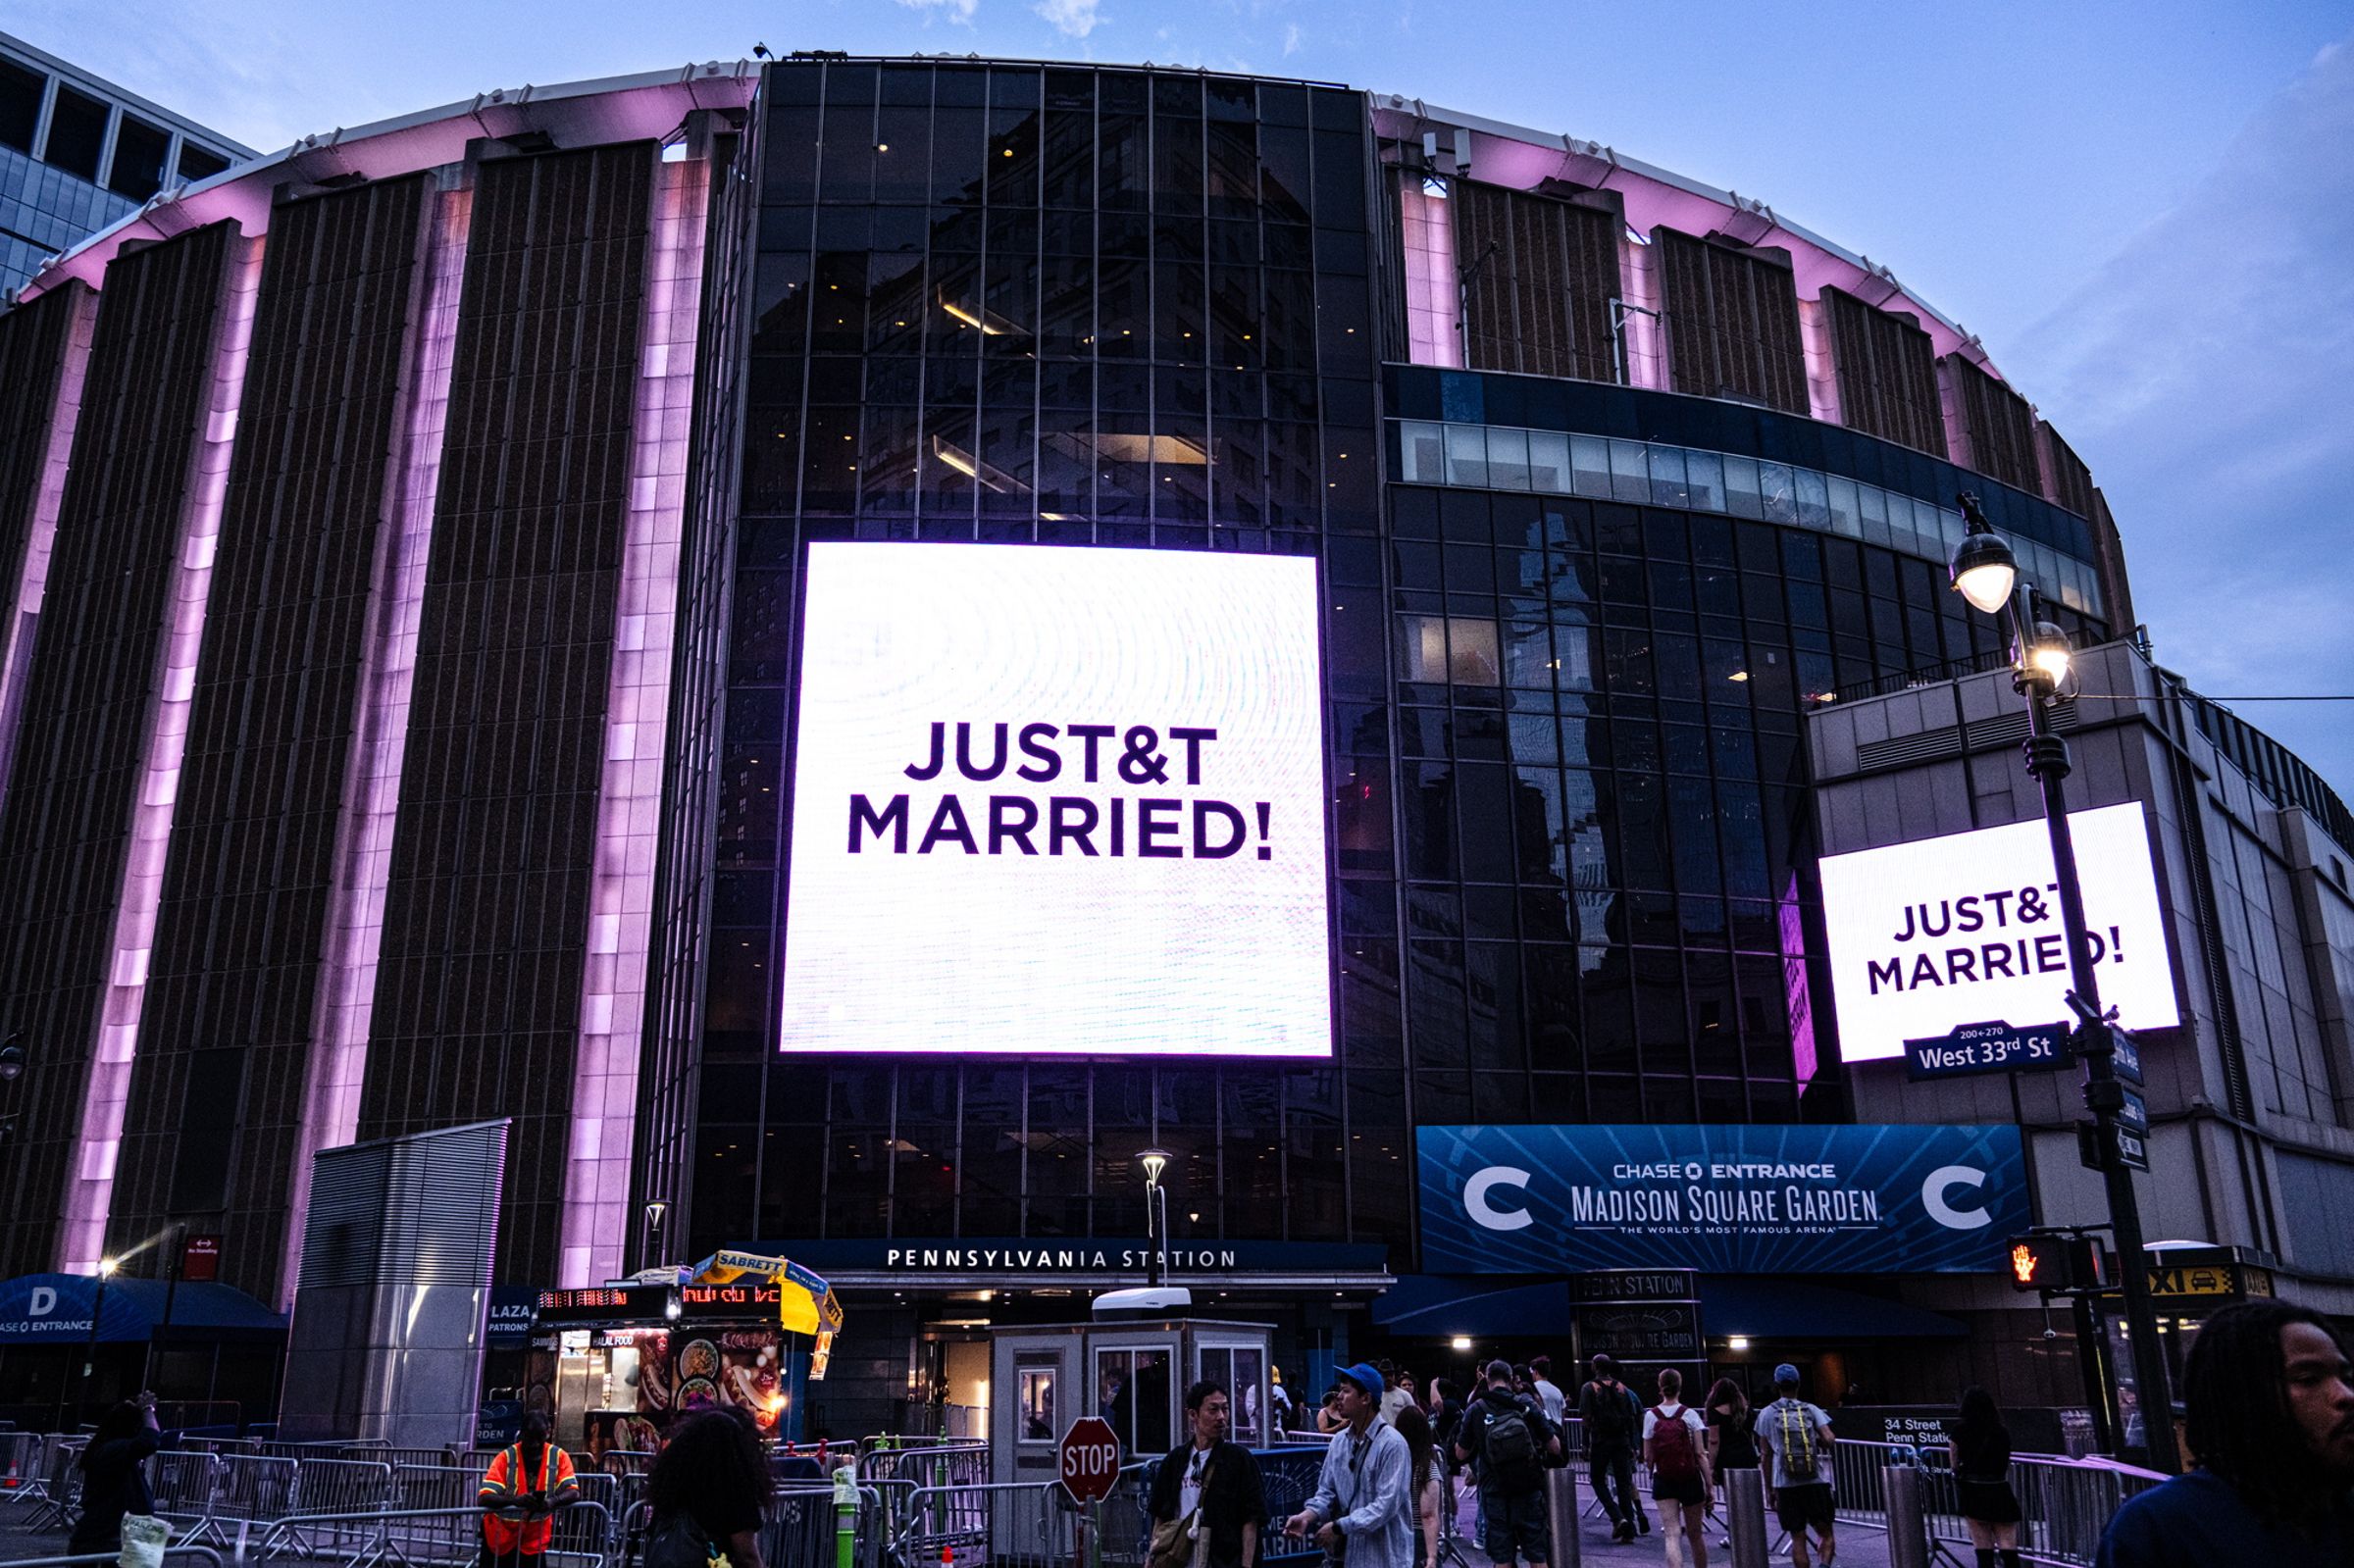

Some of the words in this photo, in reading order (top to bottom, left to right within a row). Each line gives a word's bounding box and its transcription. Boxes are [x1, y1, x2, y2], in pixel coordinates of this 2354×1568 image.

[903, 722, 1217, 785] JUST&T
[846, 793, 1272, 861] MARRIED!
[1919, 1044, 1976, 1069] West
[1980, 1037, 2021, 1063] 33rd
[2027, 1037, 2053, 1058] St
[1613, 1164, 1682, 1179] CHASE
[1711, 1164, 1836, 1179] ENTRANCE
[1463, 1165, 1534, 1232] C
[1571, 1185, 1680, 1222] MADISON
[1687, 1185, 1779, 1225] SQUARE
[1921, 1165, 1992, 1230] C
[718, 1253, 784, 1272] SABRETT
[887, 1249, 1107, 1267] PENNSYLVANIA
[1122, 1250, 1235, 1267] STATION
[1625, 1275, 1684, 1295] STATION
[29, 1287, 57, 1316] D
[489, 1305, 531, 1318] LAZA
[31, 1320, 94, 1332] ENTRANCE
[488, 1323, 530, 1332] PATRONS
[592, 1337, 614, 1346] HALAL
[614, 1336, 634, 1345] FOOD
[1884, 1419, 1901, 1431] 34
[1905, 1419, 1942, 1431] Street
[1885, 1432, 1915, 1442] Penn
[1919, 1432, 1951, 1443] Stati
[1065, 1443, 1115, 1477] STOP
